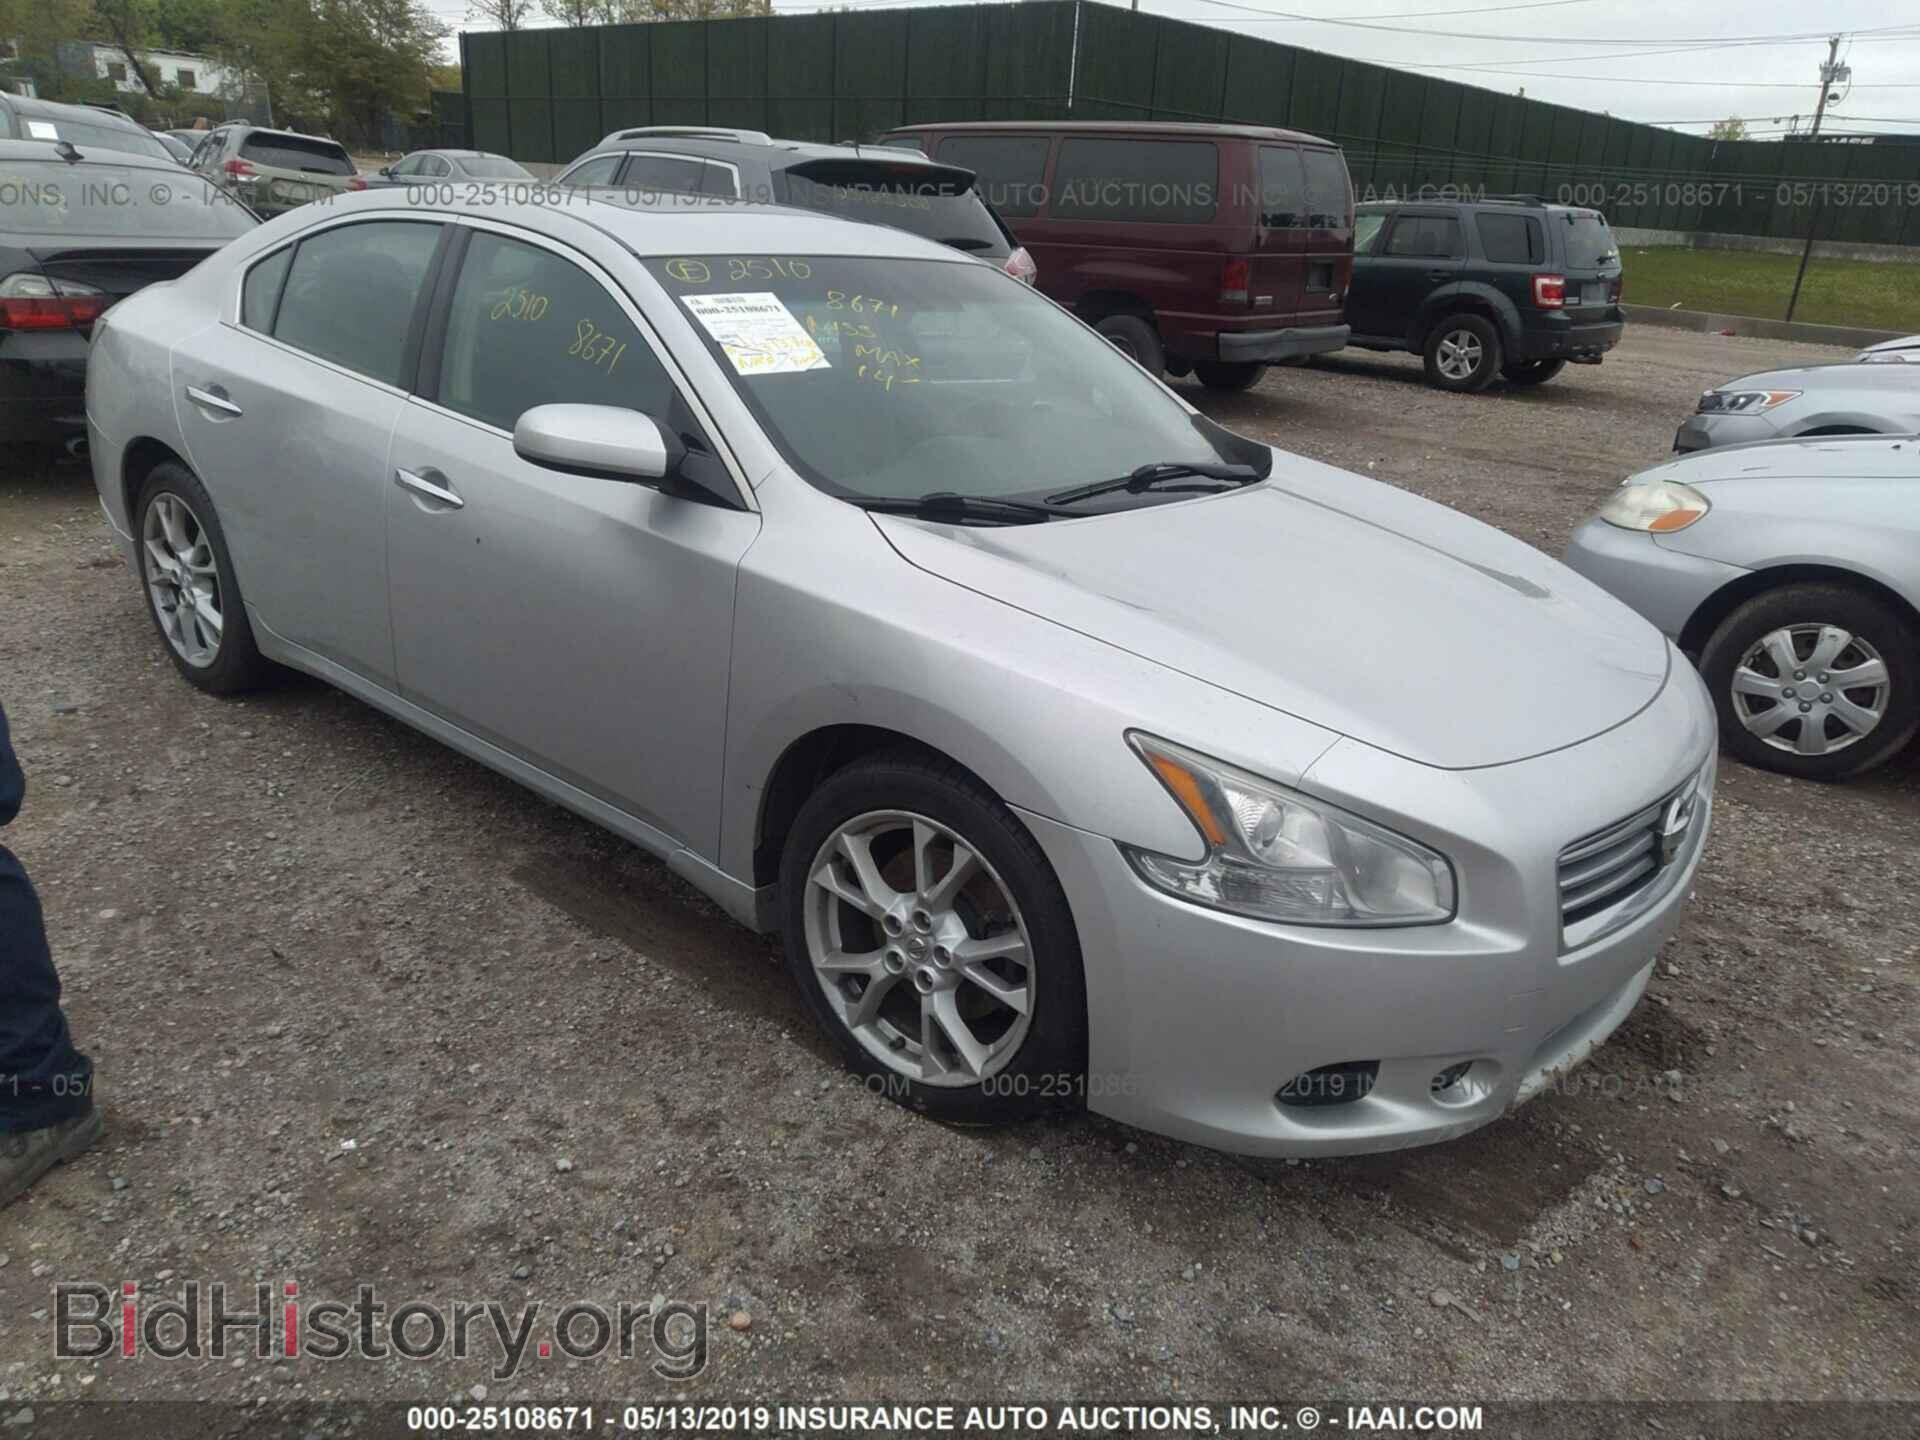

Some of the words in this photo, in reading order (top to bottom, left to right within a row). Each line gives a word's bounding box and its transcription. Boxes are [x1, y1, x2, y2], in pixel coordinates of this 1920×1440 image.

[728, 258, 811, 281] 2510
[490, 288, 549, 320] 2510
[825, 289, 898, 319] 8671
[568, 318, 627, 375] 8671
